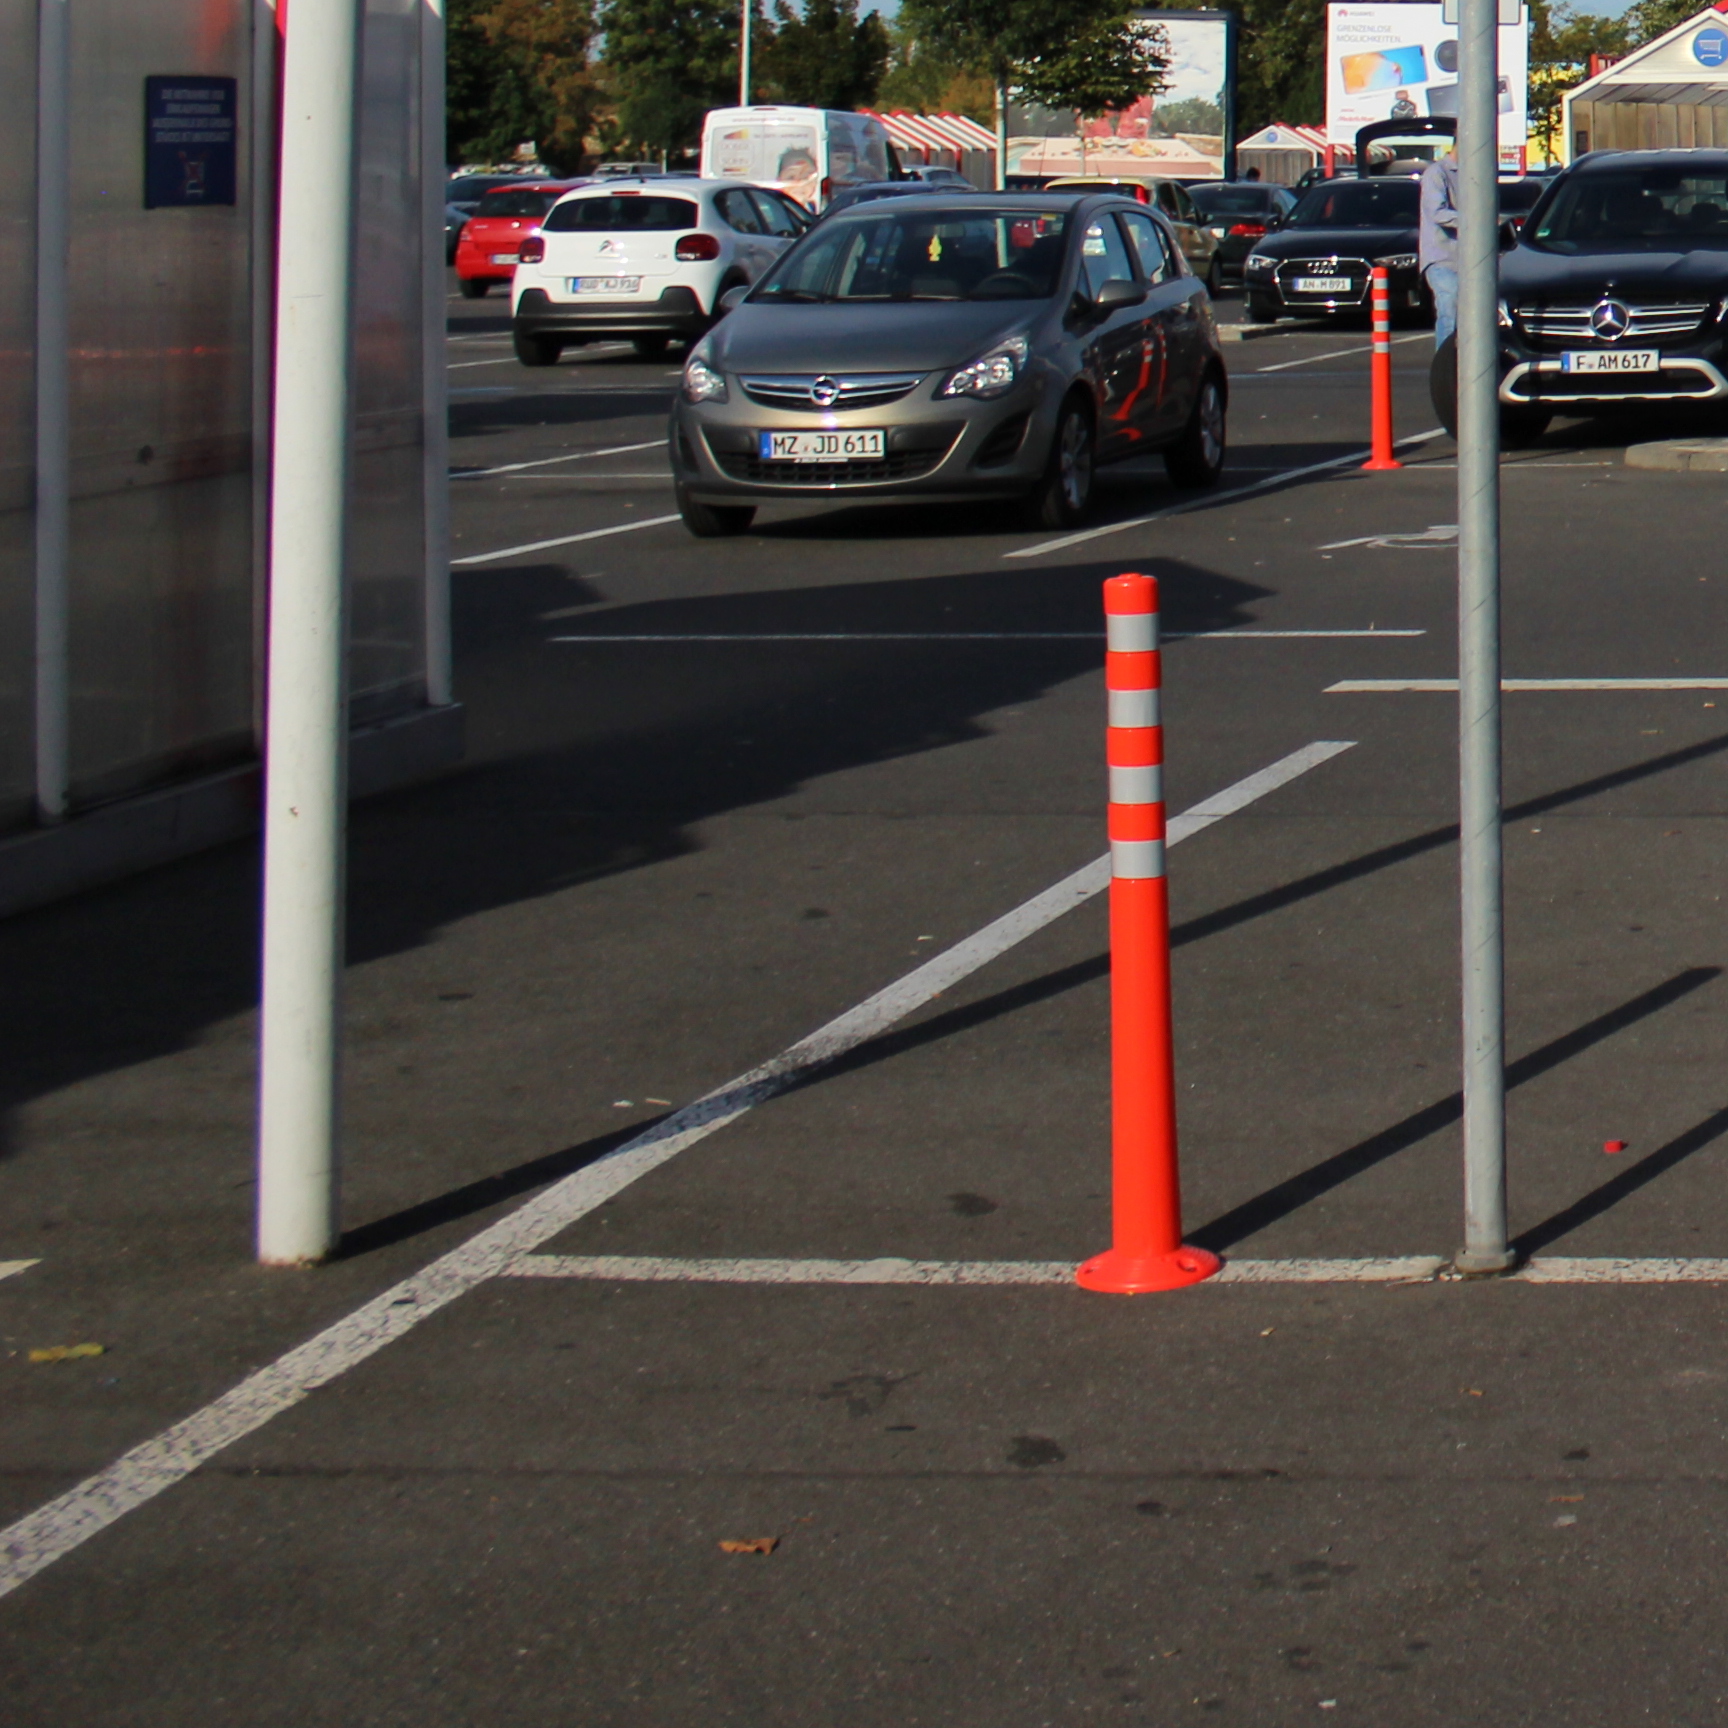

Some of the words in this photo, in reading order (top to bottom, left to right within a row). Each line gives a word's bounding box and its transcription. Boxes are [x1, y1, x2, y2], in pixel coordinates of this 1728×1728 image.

[1336, 24, 1392, 34] GRENZENLOSE
[1576, 355, 1587, 370] F
[1597, 355, 1618, 369] AM
[1621, 353, 1651, 369] 617
[773, 436, 799, 455] MZ
[812, 435, 839, 454] JD
[844, 434, 882, 453] 611
